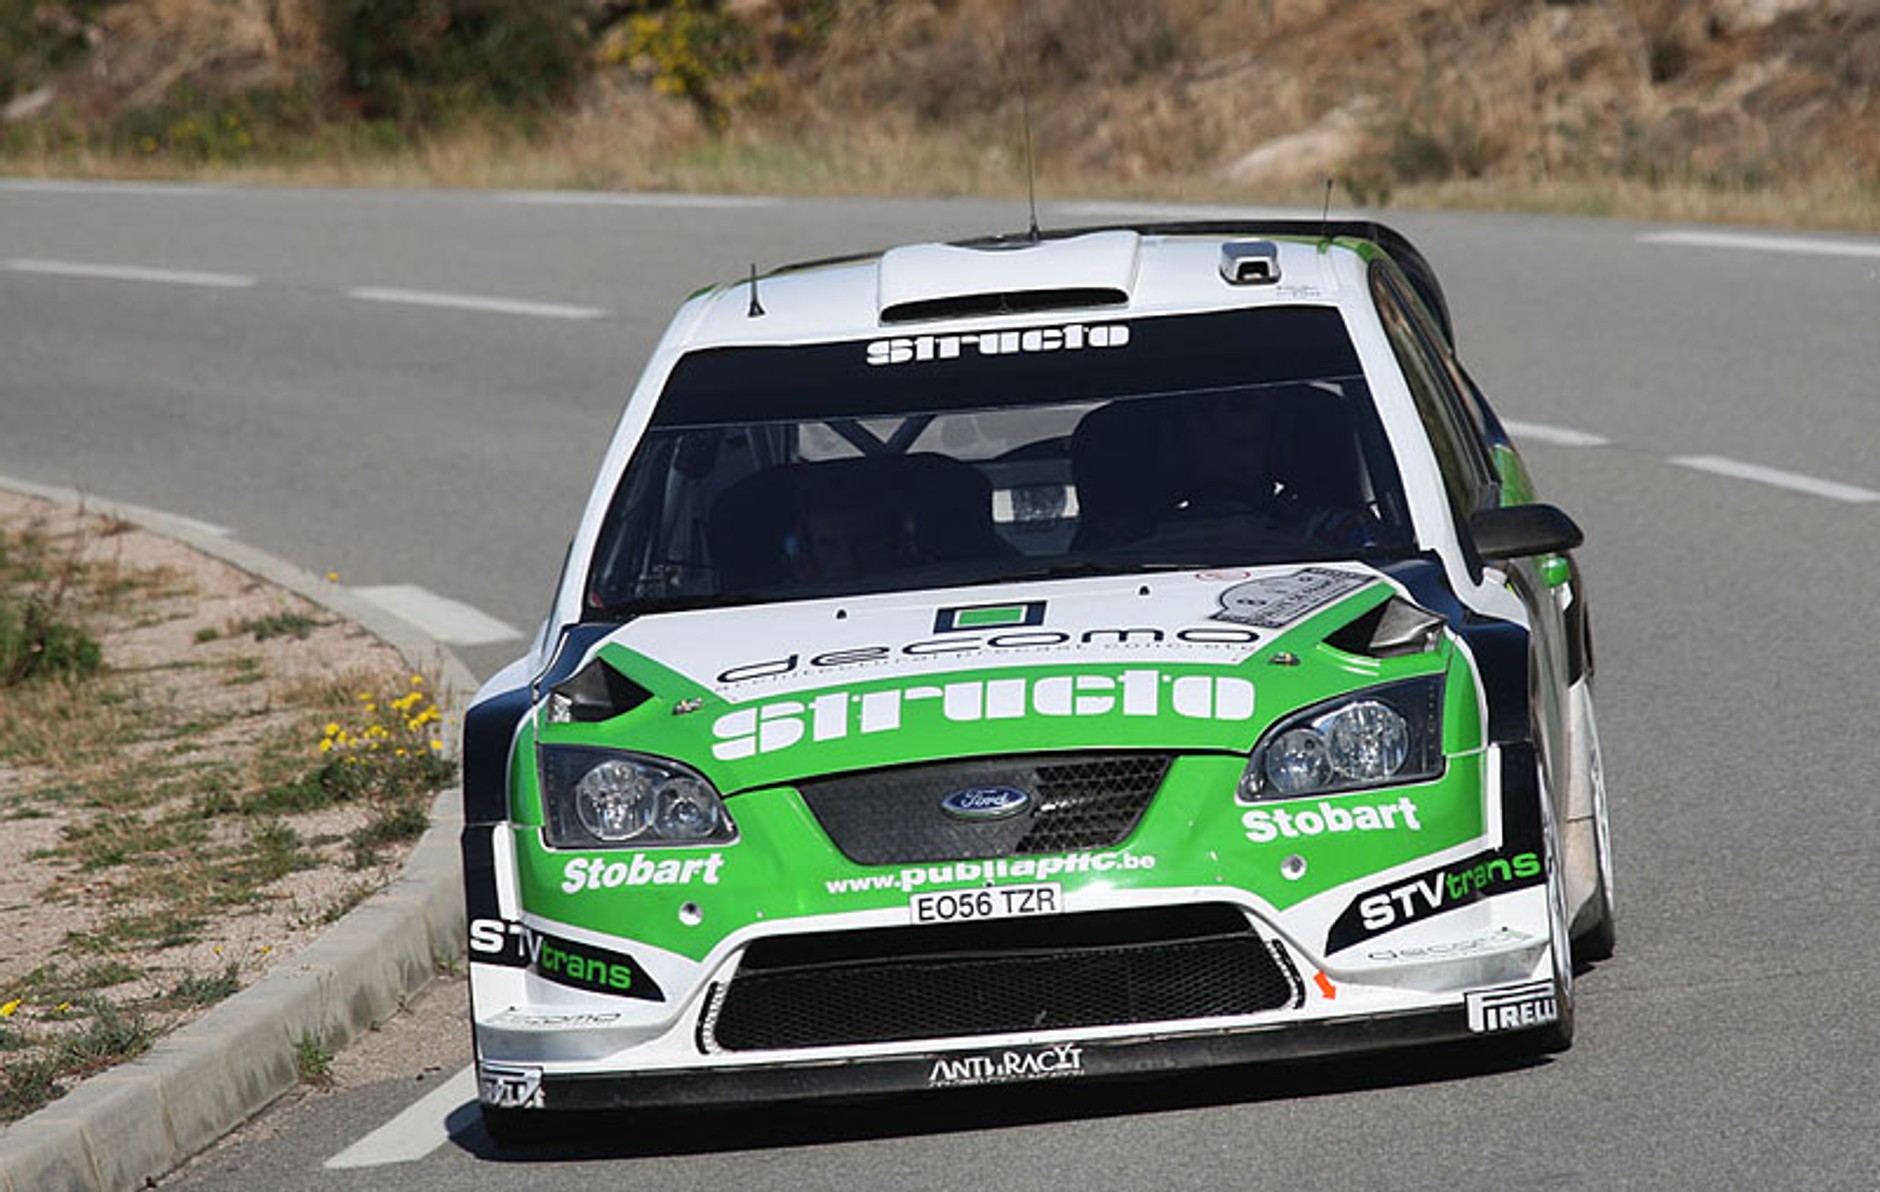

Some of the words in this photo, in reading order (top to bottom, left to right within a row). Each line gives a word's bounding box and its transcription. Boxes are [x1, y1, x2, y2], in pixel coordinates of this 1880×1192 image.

[866, 323, 1130, 366] structo
[716, 628, 1260, 683] decomo
[711, 670, 1255, 761] structo
[961, 789, 1010, 808] Ford
[1241, 796, 1421, 844] Stobart
[561, 853, 725, 895] Stobart
[918, 891, 994, 921] EO56
[1000, 889, 1056, 914] TZR
